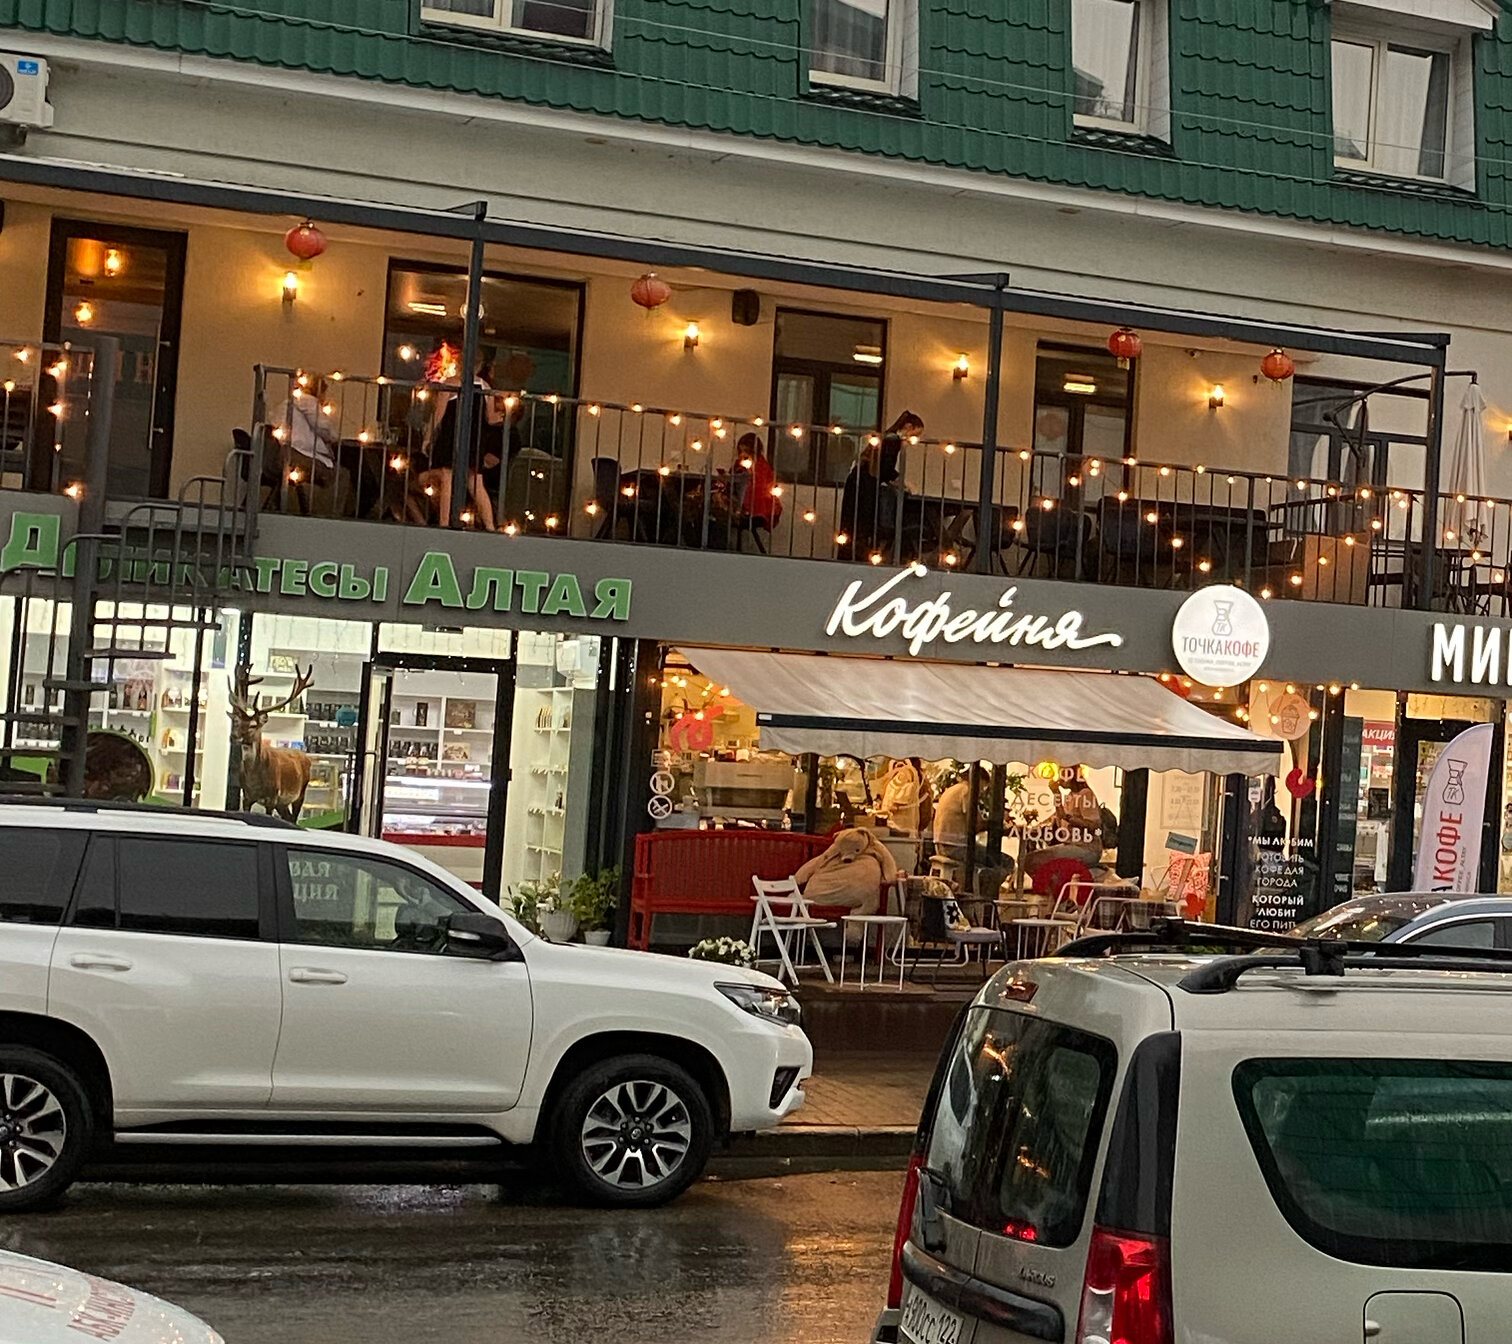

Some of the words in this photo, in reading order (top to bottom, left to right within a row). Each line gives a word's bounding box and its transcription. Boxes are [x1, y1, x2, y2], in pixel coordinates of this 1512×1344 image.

[403, 552, 633, 621] АЛТАЯ
[825, 563, 1122, 656] Кофейня
[1252, 894, 1304, 906] КОТОРЫЙ
[1250, 919, 1270, 929] ЕГО
